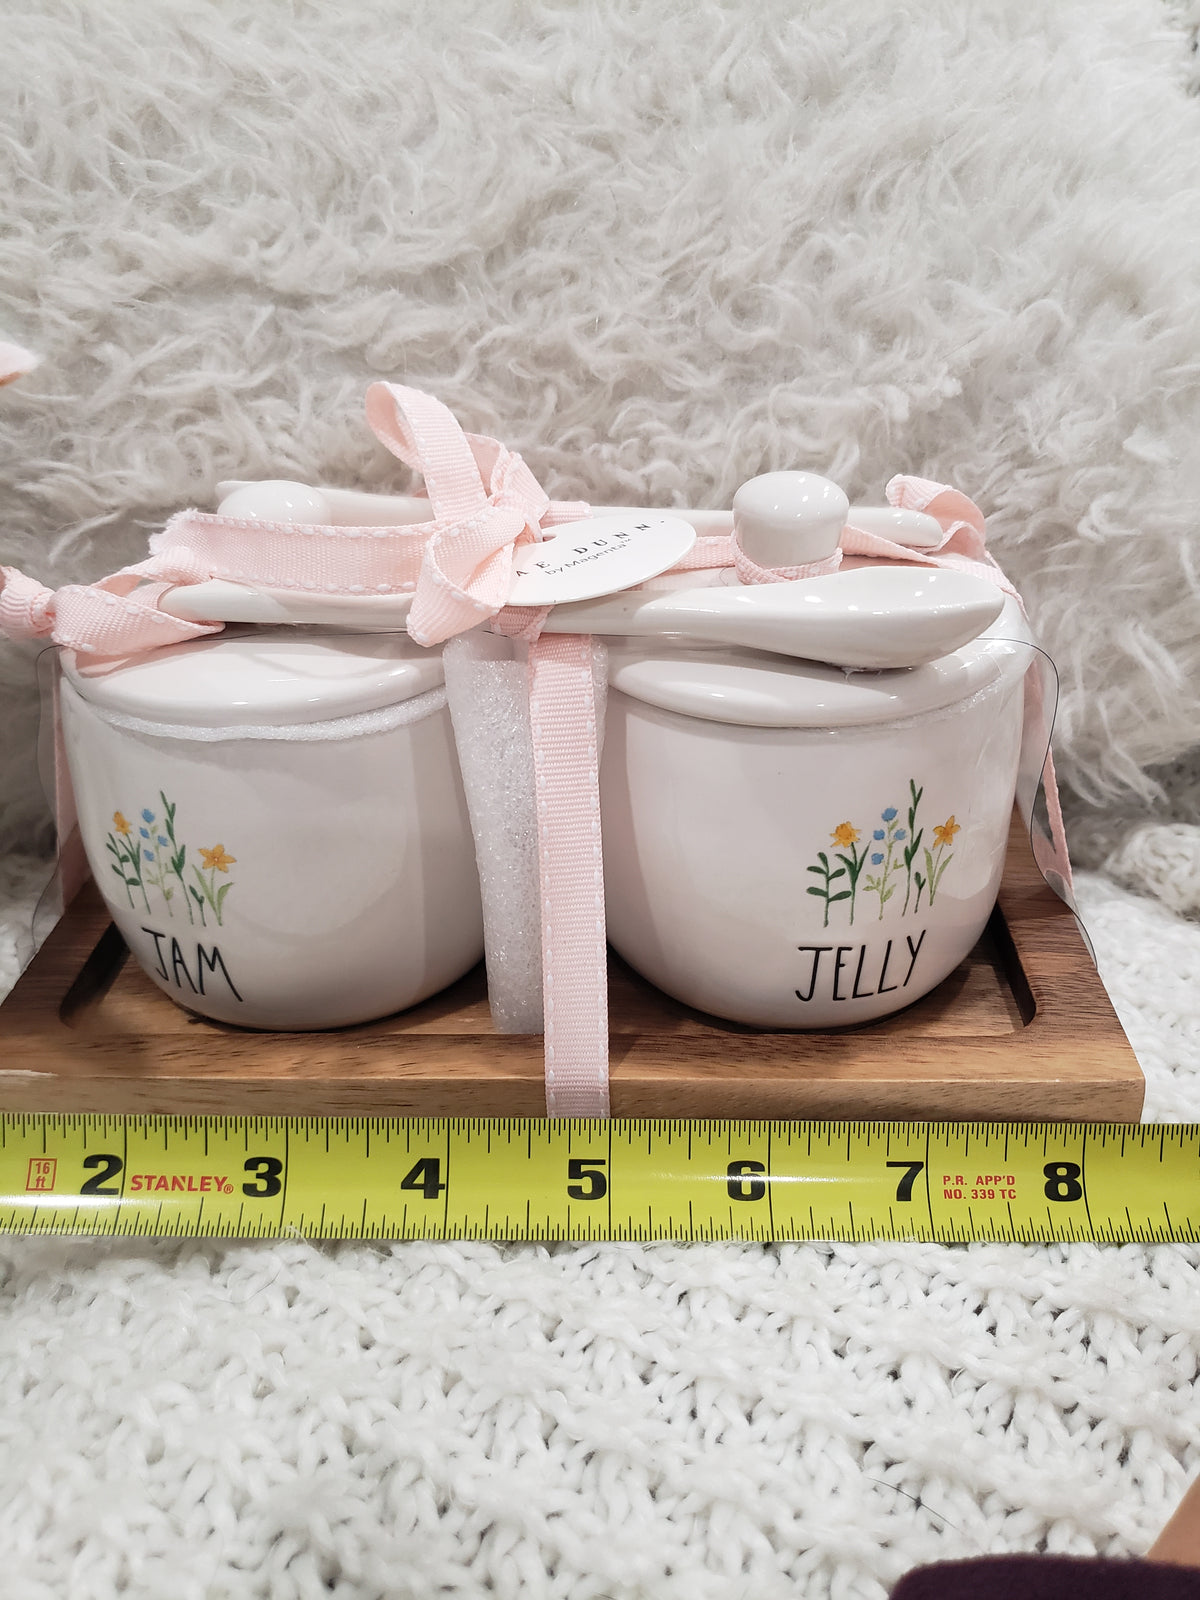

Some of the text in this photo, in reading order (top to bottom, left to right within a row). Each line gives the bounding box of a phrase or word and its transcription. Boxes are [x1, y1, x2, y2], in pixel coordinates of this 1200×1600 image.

[516, 560, 550, 577] AE
[544, 566, 564, 576] by
[141, 927, 243, 1002] JAM
[795, 929, 926, 1002] JELLY
[35, 1161, 51, 1176] 16
[35, 1176, 47, 1189] ft
[80, 1154, 124, 1196] 2
[242, 1157, 283, 1198] 3
[400, 1158, 445, 1199] 4
[567, 1159, 607, 1200] 5
[727, 1161, 766, 1201] 6
[886, 1161, 924, 1202] 7
[943, 1175, 968, 1186] P.R.
[1043, 1162, 1082, 1202] 8
[943, 1189, 1017, 1200] NO. 339 TC
